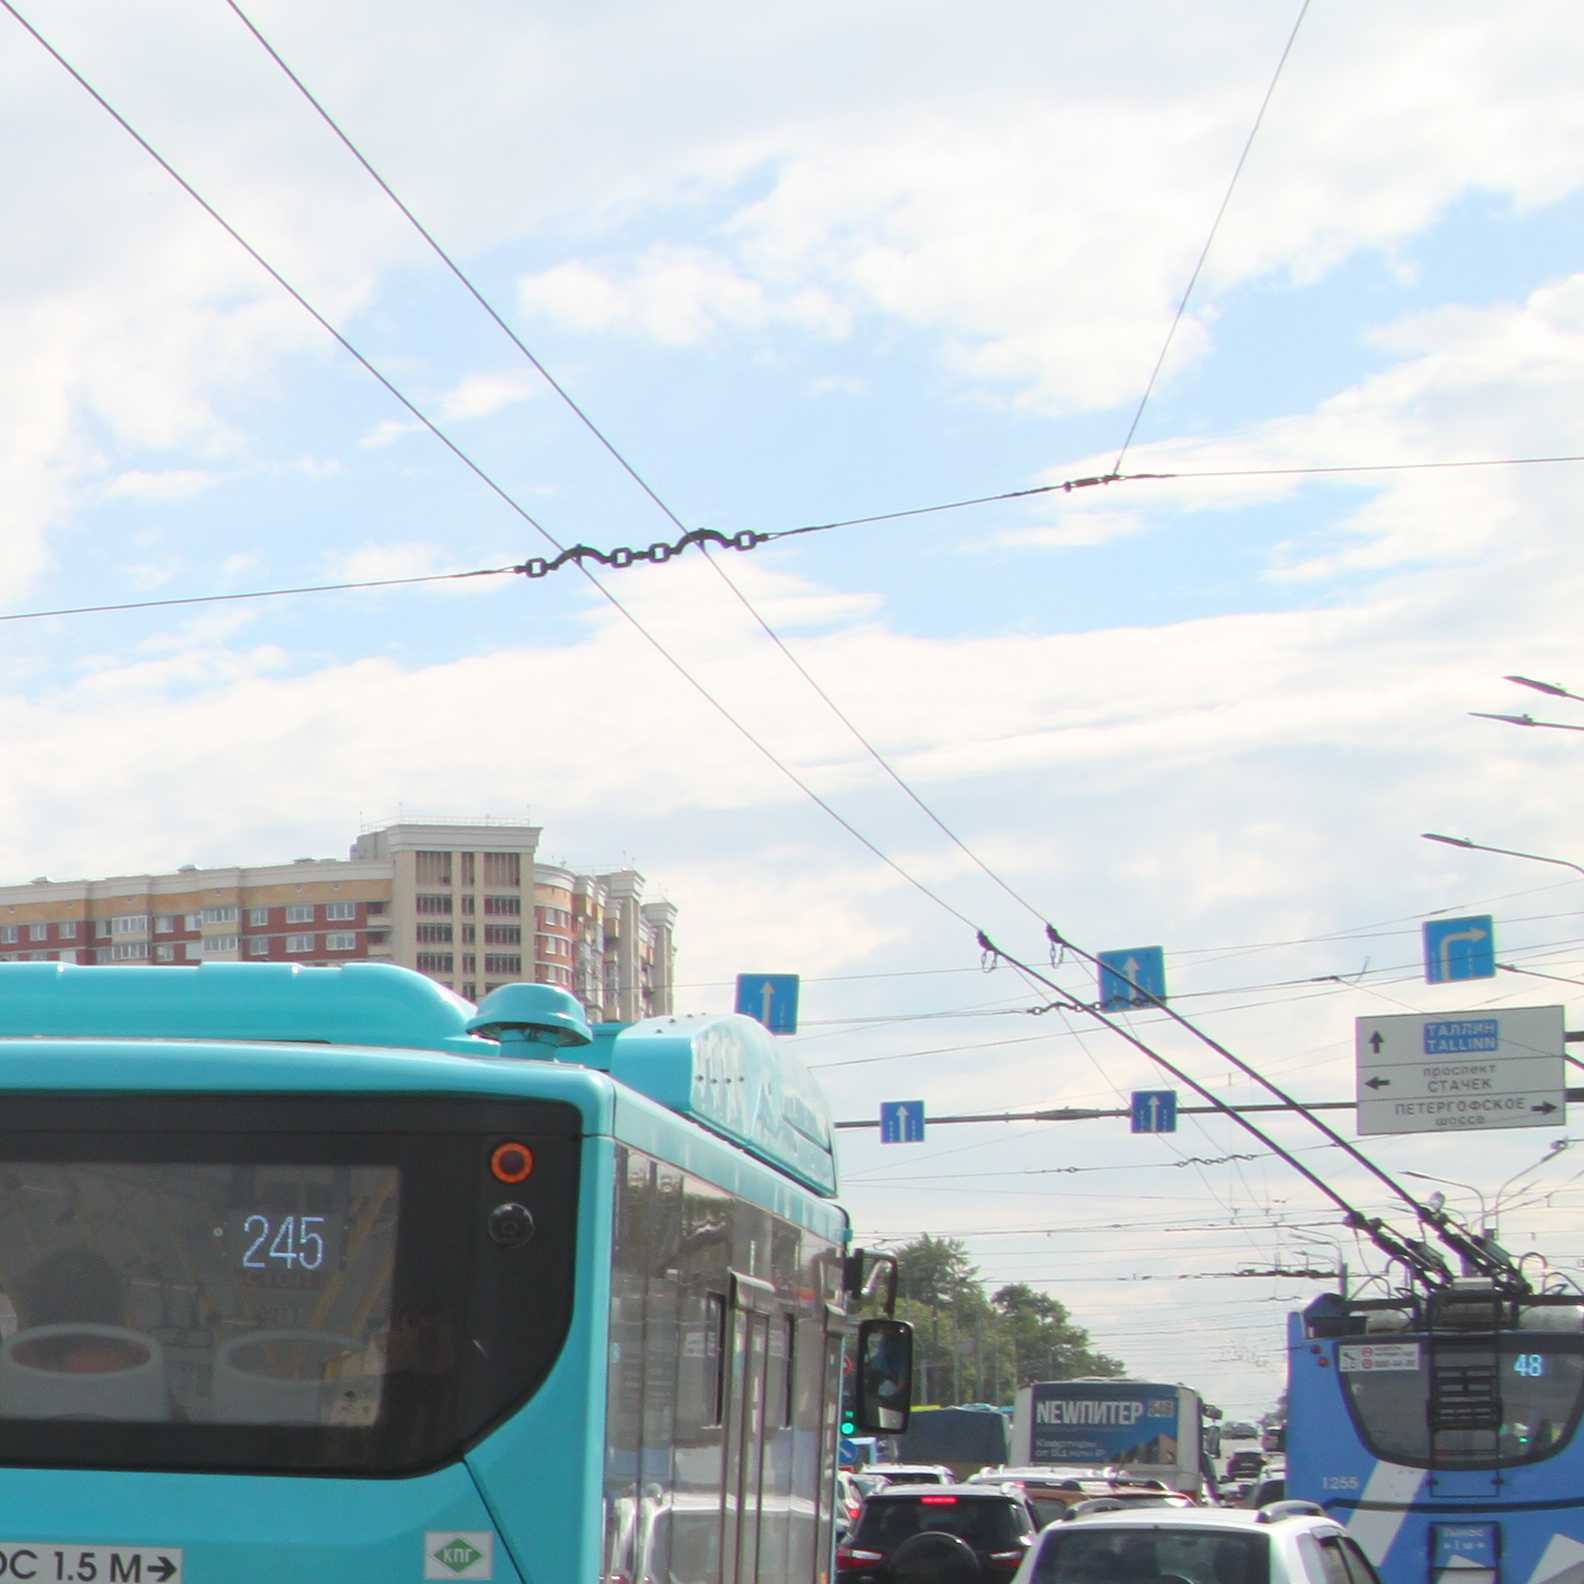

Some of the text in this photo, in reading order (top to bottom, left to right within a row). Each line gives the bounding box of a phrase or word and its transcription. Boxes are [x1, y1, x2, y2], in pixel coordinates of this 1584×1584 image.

[1427, 1037, 1497, 1052] TALLINN
[1423, 1065, 1497, 1078] проспект
[1427, 1078, 1494, 1094] СТАЧЕК
[1394, 1097, 1527, 1116] ПЕТЕРГОФСКОЕ
[1435, 1115, 1486, 1127] шоссе
[242, 1215, 325, 1270] 245
[1513, 1354, 1543, 1377] 48
[1036, 1400, 1144, 1425] NEWПИТЕР
[443, 1548, 472, 1563] КПГ
[53, 1551, 98, 1582] 1.5
[109, 1553, 142, 1583] М
